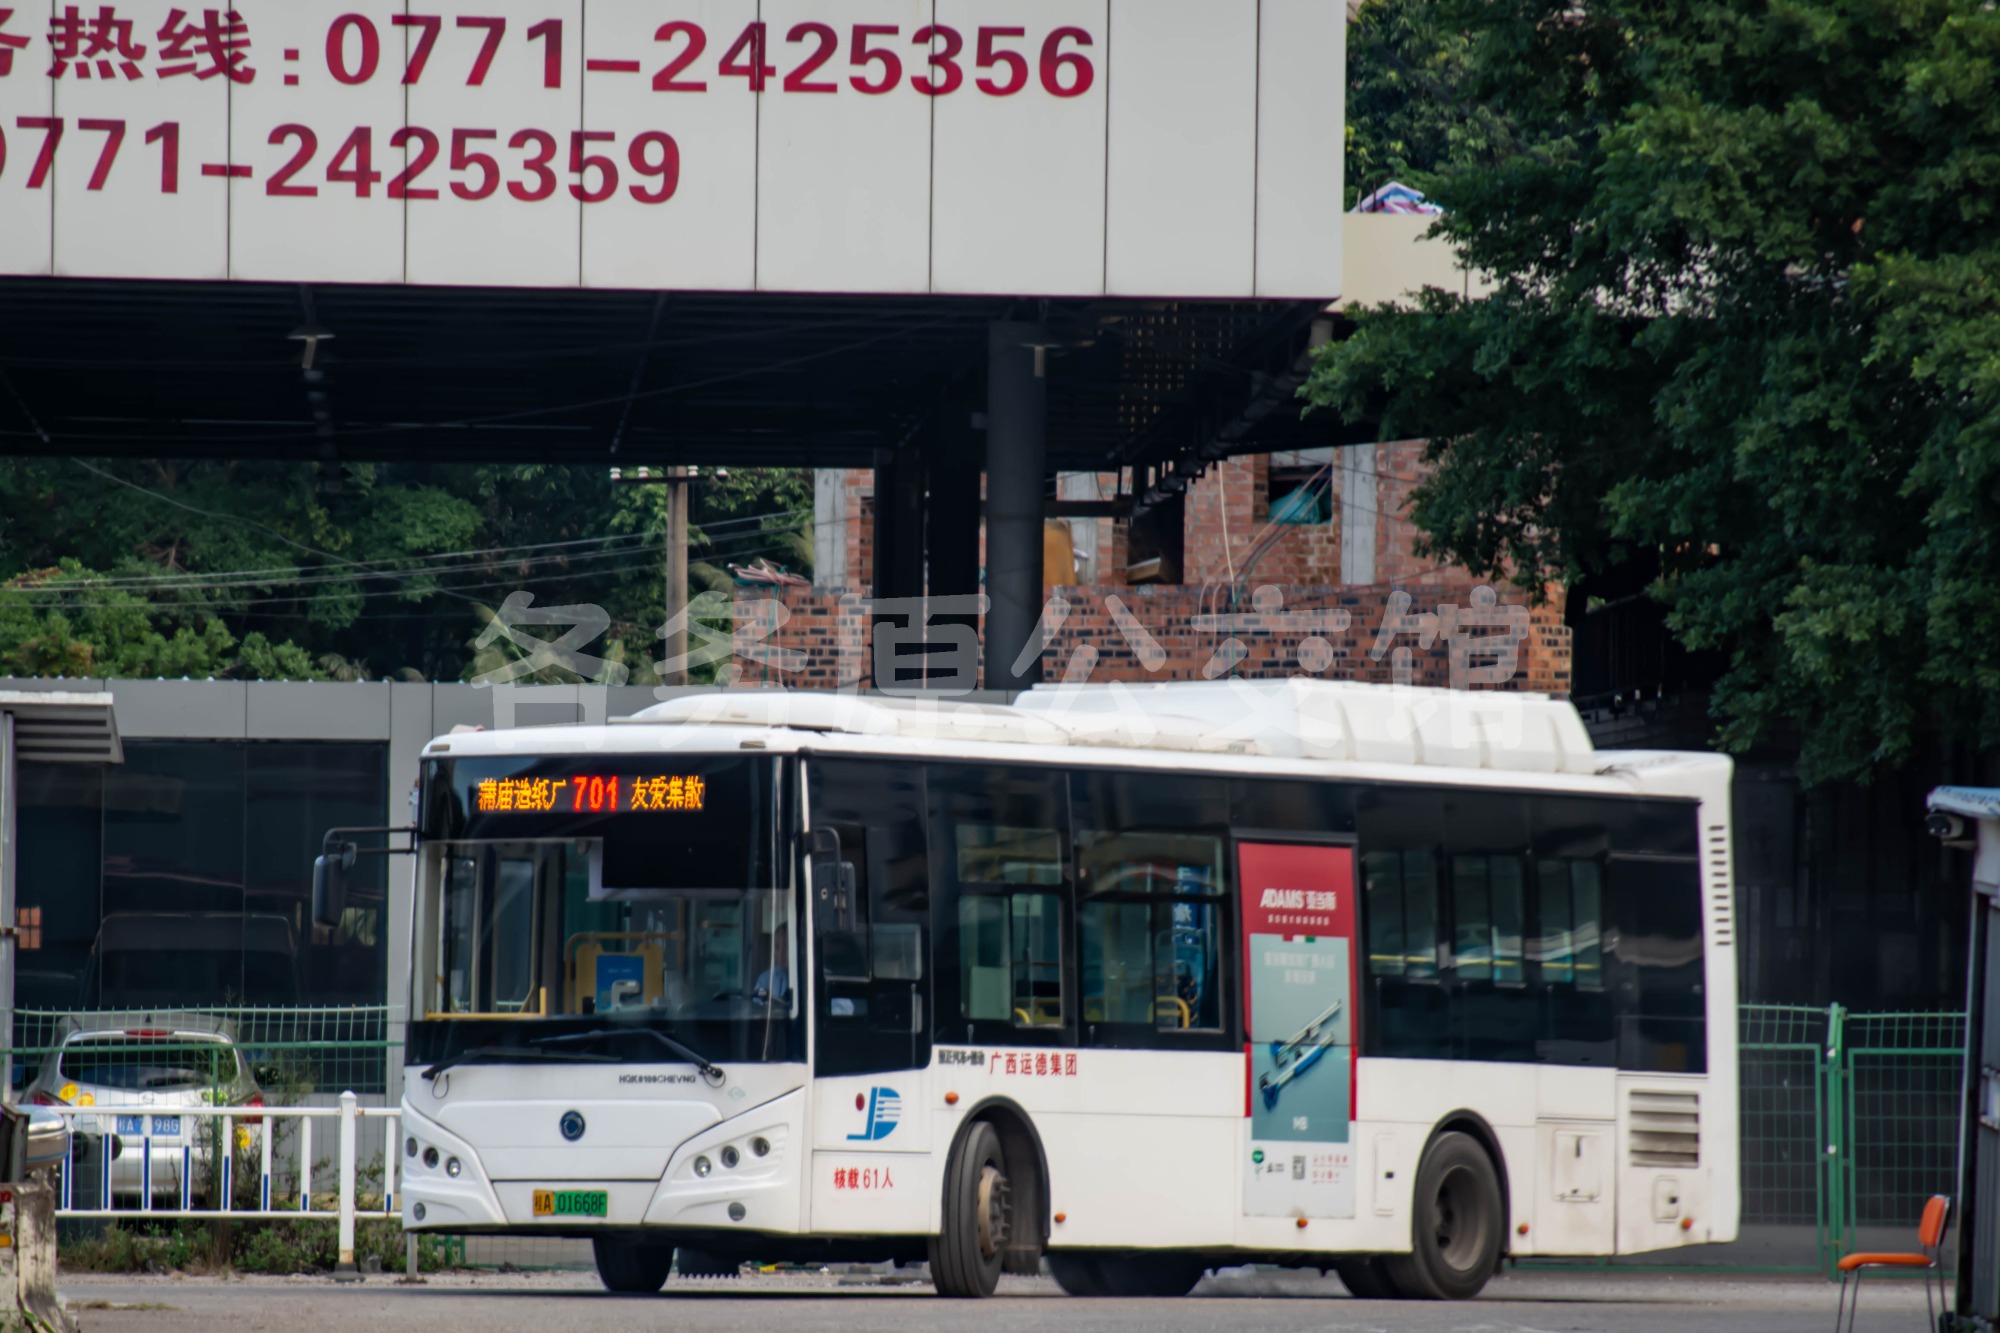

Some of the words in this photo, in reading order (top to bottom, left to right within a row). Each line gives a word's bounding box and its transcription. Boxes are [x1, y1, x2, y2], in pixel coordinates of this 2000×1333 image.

[0, 115, 680, 205] 771-2425359
[573, 775, 619, 812] 701
[630, 775, 705, 811] 友爱集散
[1260, 888, 1305, 909] ADAMS
[989, 1051, 1078, 1077] 广西运德集团
